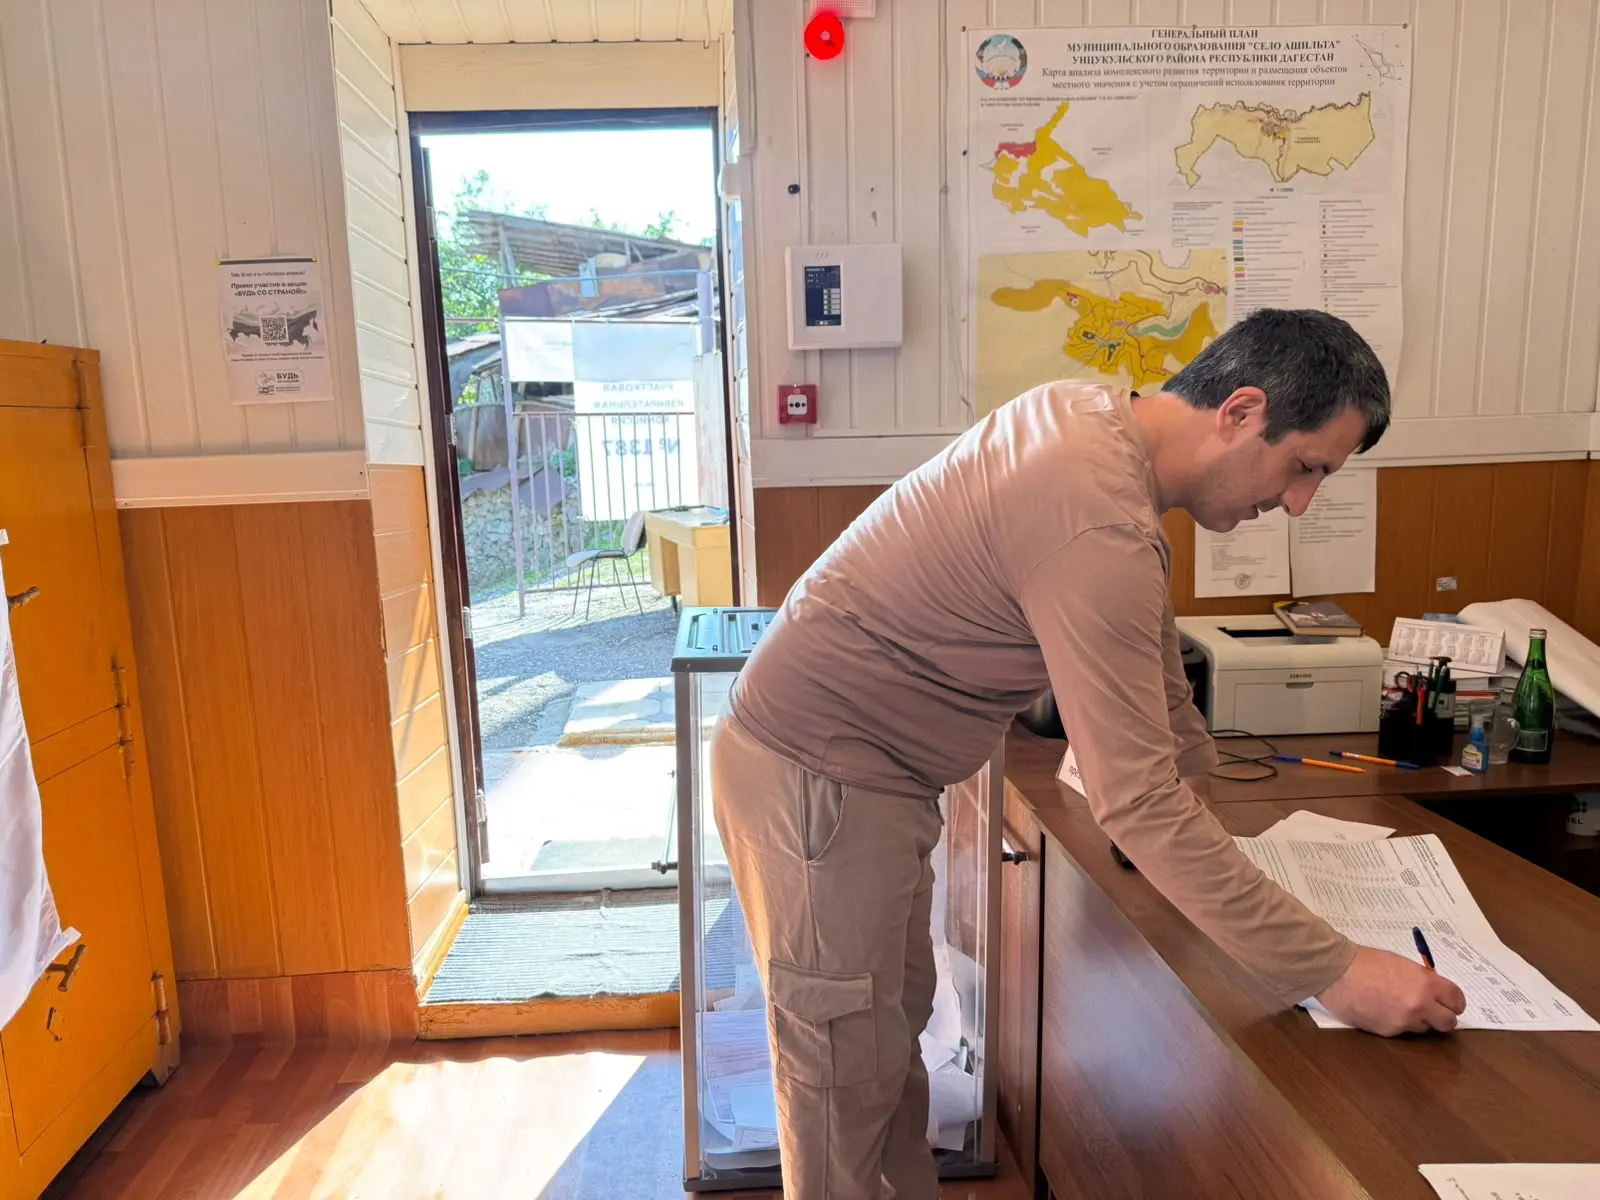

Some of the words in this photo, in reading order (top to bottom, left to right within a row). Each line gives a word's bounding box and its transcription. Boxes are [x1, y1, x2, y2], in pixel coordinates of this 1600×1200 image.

[1151, 28, 1227, 39] ГЕНЕРАЛЬНЫЙ
[1229, 29, 1258, 38] ПЛАН
[1066, 42, 1172, 53] МУНИЦИПАЛЬНОГО
[1173, 41, 1246, 52] ОБРАЗОВАНИЯ
[1248, 41, 1281, 51] "СЕЛО
[1283, 40, 1341, 50] АШИЛЬТА"
[1072, 54, 1164, 65] УНЦУКУЛЬСКОГО
[1166, 52, 1206, 64] РАЙОНА
[1209, 53, 1277, 63] РЕСПУБЛИКИ
[1279, 52, 1334, 63] ДАГЕСТАН
[1041, 67, 1067, 79] Карта
[1068, 69, 1101, 77] анализа
[1103, 68, 1162, 77] комплексного
[1163, 68, 1200, 78] развития
[1202, 67, 1249, 77] территории
[1251, 67, 1257, 75] и
[1258, 67, 1308, 77] размещения
[1309, 64, 1348, 74] объектов
[1052, 81, 1091, 89] местного
[1093, 80, 1131, 88] значения
[1132, 80, 1138, 88] с
[1140, 80, 1169, 90] учетом
[1169, 78, 1224, 90] ограничений
[1225, 79, 1286, 88] использования
[1288, 78, 1335, 89] территории
[276, 372, 299, 380] БУДЬ
